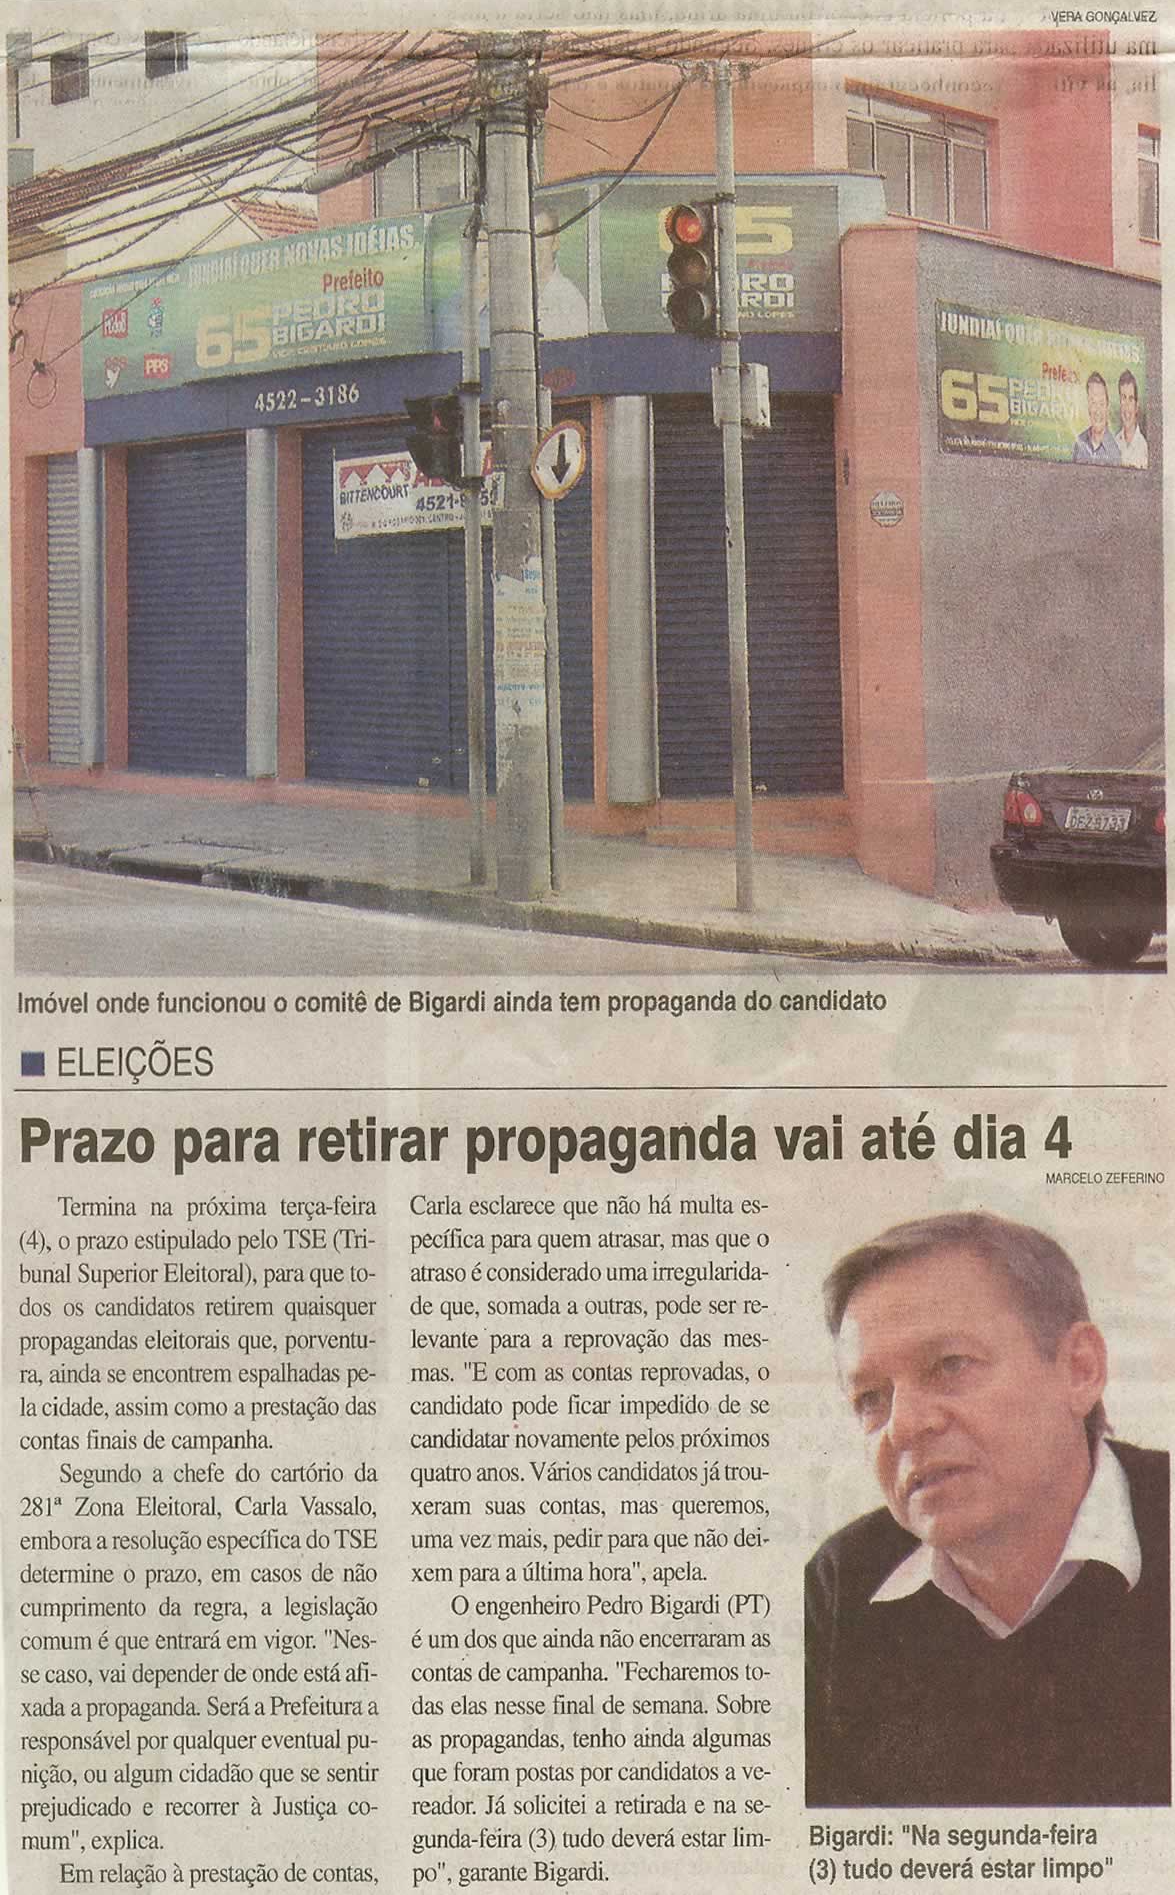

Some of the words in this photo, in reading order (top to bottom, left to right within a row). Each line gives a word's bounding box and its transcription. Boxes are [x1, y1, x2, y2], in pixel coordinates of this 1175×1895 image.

[1050, 10, 1083, 23] VERA
[1085, 10, 1158, 25] GONÇALVEZ
[658, 205, 793, 256] 5
[322, 266, 384, 294] Prefeito
[272, 290, 385, 325] PEDRO
[196, 306, 272, 369] 65
[272, 312, 386, 347] BIGARDI
[144, 358, 169, 375] PPS
[941, 368, 1009, 425] 65
[339, 483, 410, 506] BITTENCOURT
[18, 991, 88, 1014] Imóvel
[96, 991, 150, 1014] onde
[156, 991, 266, 1014] funcionou
[273, 996, 288, 1013] o
[294, 989, 368, 1013] comitê
[374, 990, 402, 1014] de
[409, 990, 486, 1019] Bigardi
[493, 990, 553, 1013] ainda
[558, 991, 601, 1013] tem
[607, 989, 737, 1018] propaganda
[743, 989, 773, 1012] do
[779, 989, 887, 1012] candidato
[58, 1039, 214, 1086] ELEIÇÕES
[20, 1117, 155, 1164] Prazo
[174, 1126, 281, 1176] para
[298, 1115, 449, 1163] retirar
[466, 1114, 757, 1175] propaganda
[773, 1113, 843, 1162] vai
[861, 1110, 936, 1162] até
[953, 1113, 1027, 1161] dia
[1043, 1114, 1073, 1160] 4
[1045, 1172, 1103, 1185] MARCELO
[1105, 1171, 1165, 1185] ZEFERINO
[57, 1195, 137, 1217] Termina
[150, 1201, 174, 1217] na
[186, 1195, 267, 1222] próxima
[280, 1194, 377, 1222] terça-feira
[410, 1265, 467, 1283] atraso
[470, 1261, 483, 1282] é
[486, 1260, 602, 1283] considerado
[606, 1266, 649, 1282] uma
[652, 1259, 769, 1288] irregularida-
[19, 1329, 138, 1356] propagandas
[144, 1329, 231, 1350] eleitorais
[237, 1334, 278, 1356] que,
[285, 1331, 376, 1355] porventu-
[19, 1496, 63, 1518] 281ª
[74, 1496, 125, 1517] Zona
[135, 1495, 222, 1520] Eleitoral,
[234, 1495, 289, 1517] Carla
[299, 1495, 377, 1519] Vassalo,
[410, 1500, 471, 1516] xeram
[484, 1500, 526, 1516] suas
[539, 1497, 606, 1518] contas,
[620, 1499, 659, 1515] mas
[671, 1499, 770, 1521] queremos,
[411, 1567, 454, 1583] xem
[458, 1567, 501, 1588] para
[505, 1566, 517, 1582] a
[522, 1560, 585, 1582] última
[588, 1561, 647, 1585] hora",
[652, 1560, 708, 1587] apela.
[19, 1596, 147, 1623] cumprimento
[158, 1595, 182, 1617] da
[194, 1601, 248, 1623] regra,
[260, 1601, 273, 1617] a
[284, 1594, 378, 1622] legislação
[809, 1824, 893, 1852] Bigardi:
[901, 1823, 941, 1847] "Na
[947, 1823, 1098, 1852] segunda-feira
[412, 1861, 452, 1888] po",
[458, 1865, 528, 1888] garante
[533, 1860, 609, 1888] Bigardi.
[808, 1857, 837, 1886] (3)
[842, 1857, 893, 1880] tudo
[899, 1856, 974, 1880] deverá
[980, 1858, 1036, 1880] estar
[1042, 1856, 1113, 1884] limpo"
